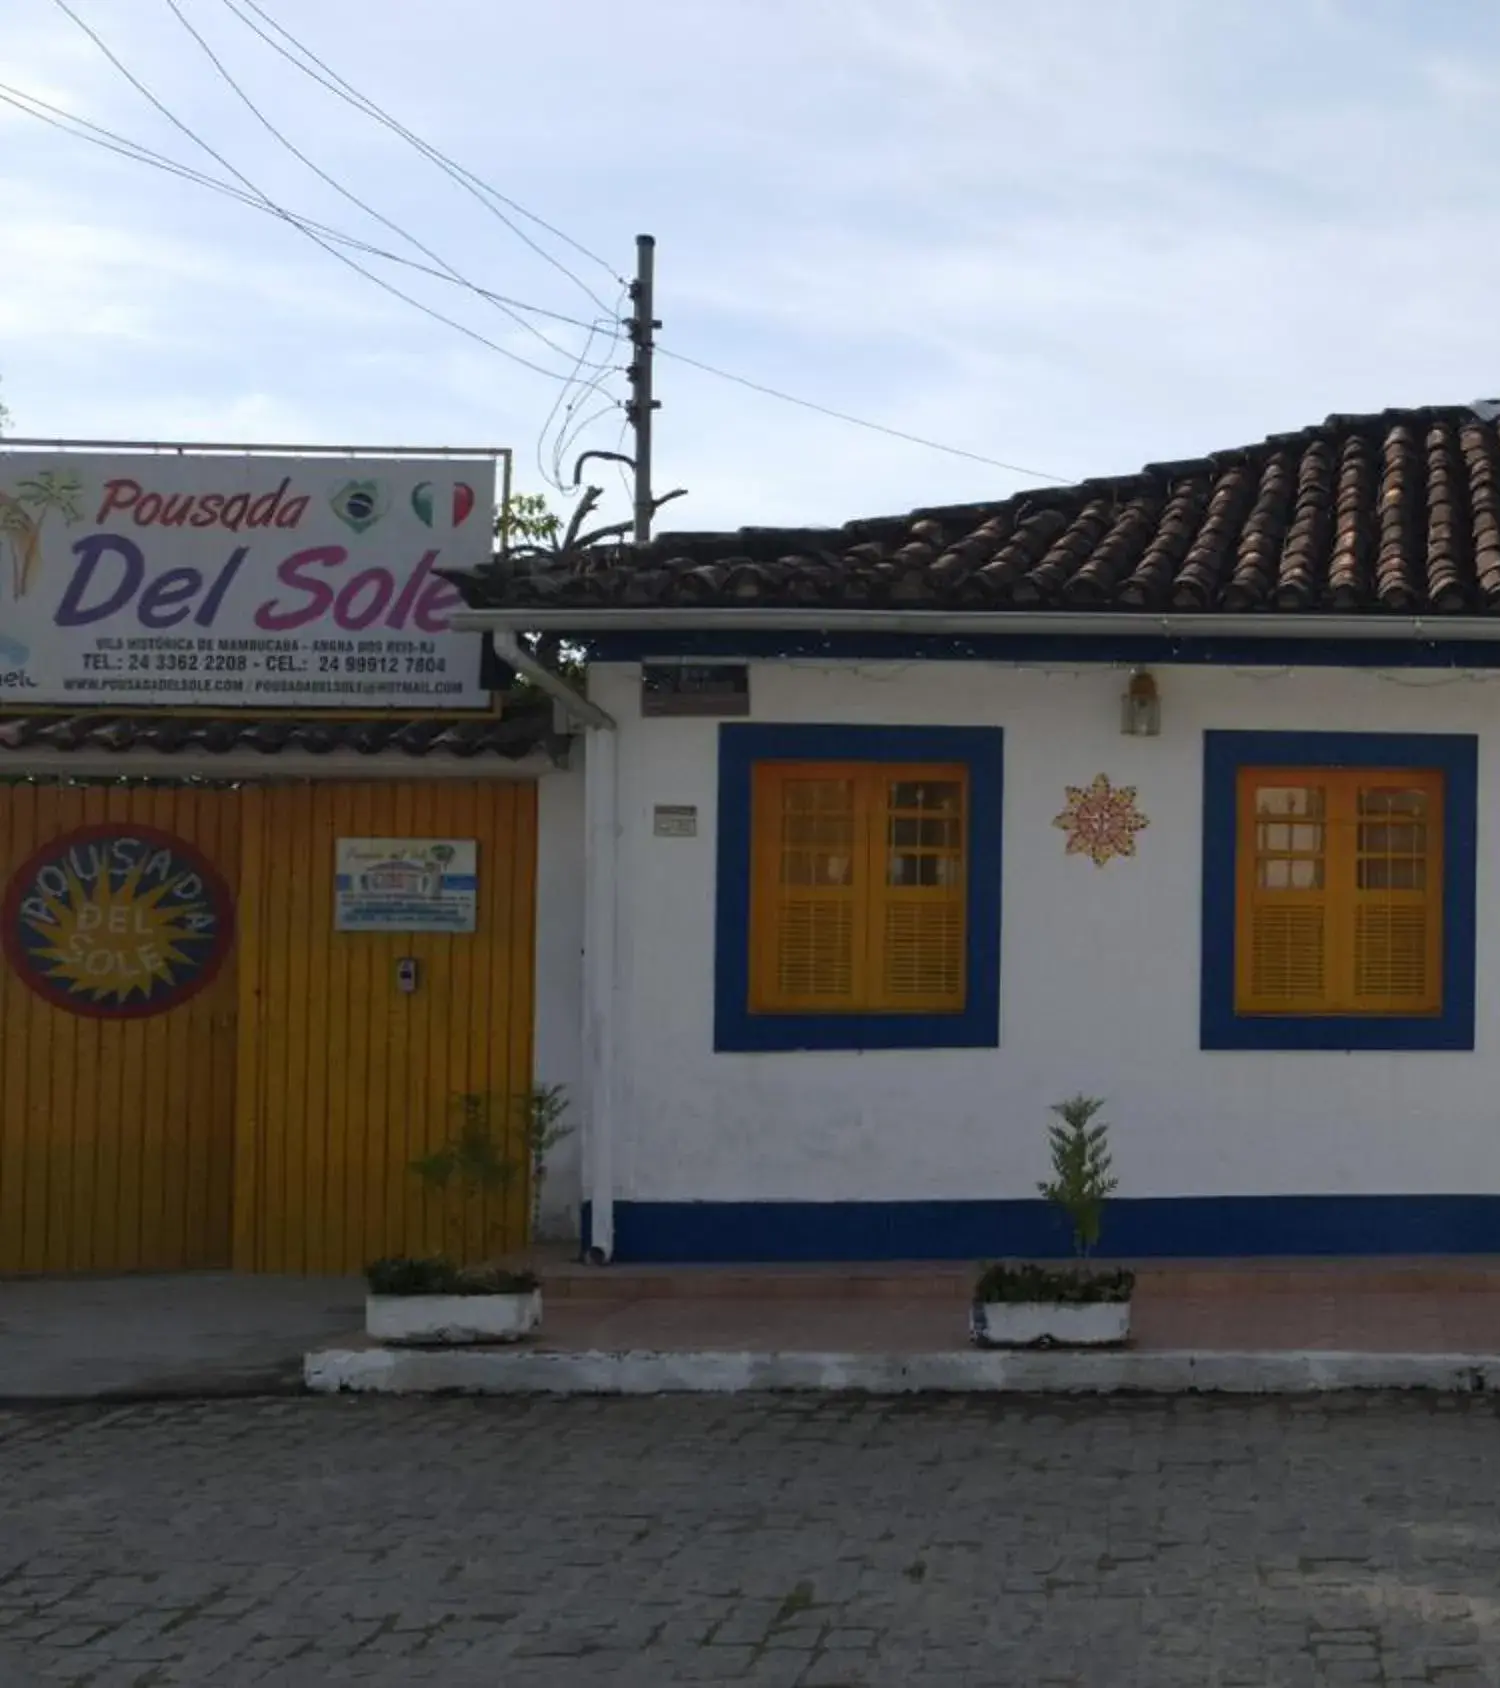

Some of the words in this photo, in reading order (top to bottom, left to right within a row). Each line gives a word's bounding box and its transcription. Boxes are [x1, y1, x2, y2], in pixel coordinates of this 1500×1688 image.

[96, 476, 311, 533] Pousada
[54, 533, 250, 630] Del
[254, 544, 463, 633] Sole
[82, 653, 123, 670] TEL.:
[128, 654, 150, 671] 24
[155, 655, 199, 671] 3362
[204, 655, 247, 671] 2208
[266, 655, 308, 672] CEL.:
[319, 656, 339, 672] 24
[345, 656, 398, 673] 99912
[197, 638, 214, 651] DE
[20, 837, 215, 930] POUSADA
[77, 903, 154, 934] DEL
[69, 932, 165, 976] SOLE
